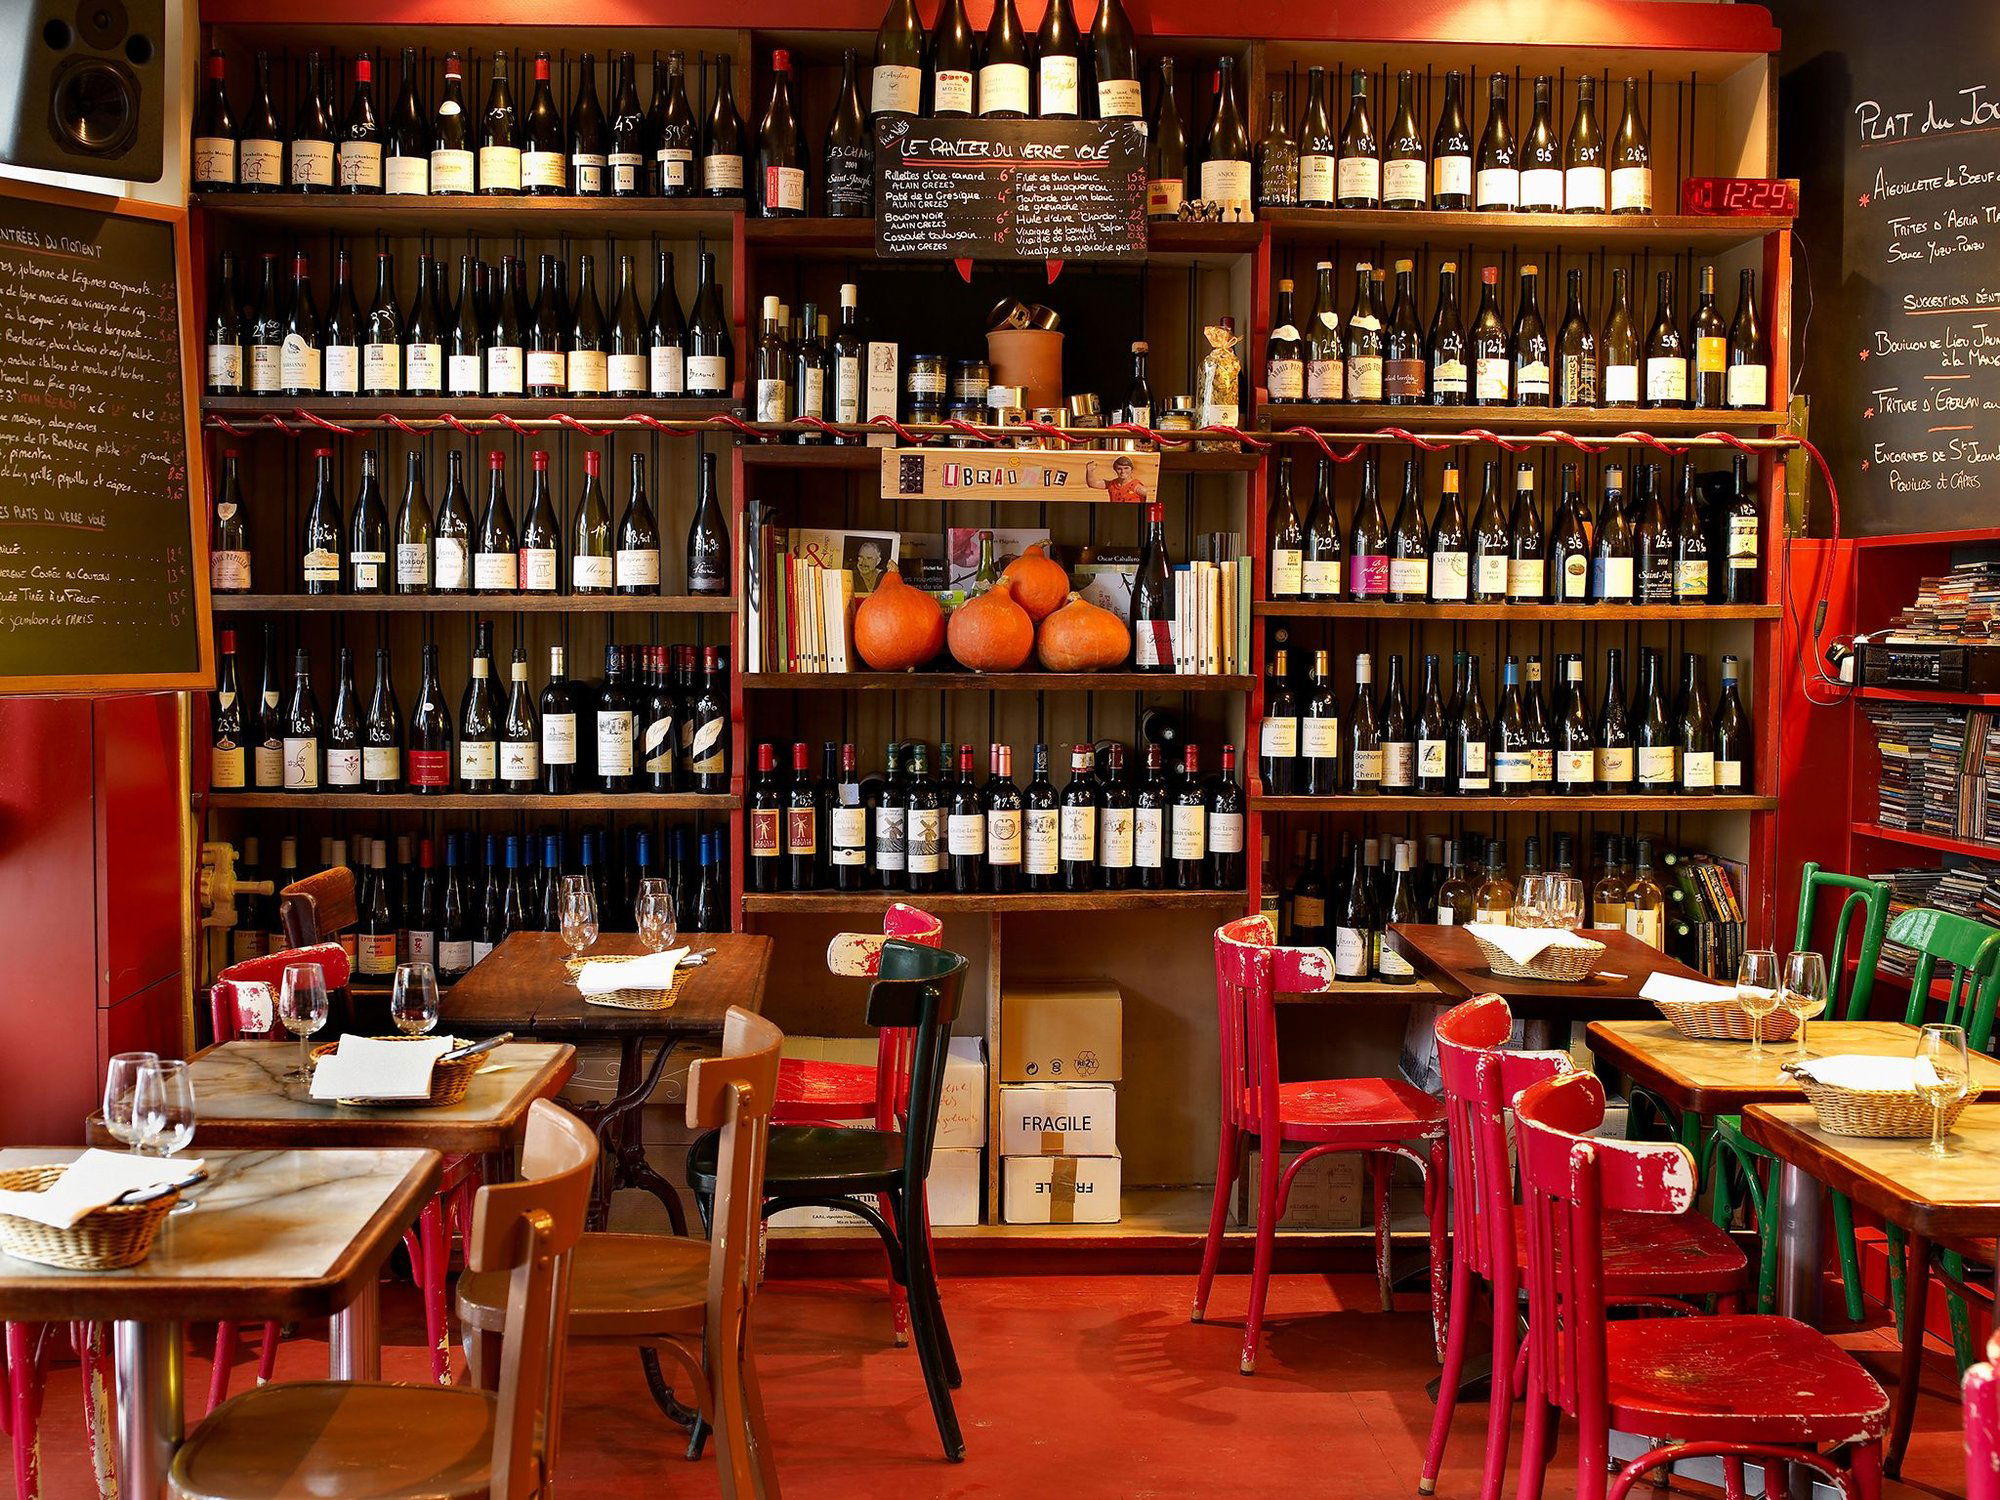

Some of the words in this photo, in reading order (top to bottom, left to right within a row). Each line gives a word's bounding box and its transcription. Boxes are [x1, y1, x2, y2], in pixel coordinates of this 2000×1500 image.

[1921, 99, 1955, 134] du
[900, 138, 929, 157] LE
[928, 137, 991, 157] PANIER
[992, 142, 1014, 157] DU
[1019, 142, 1070, 160] VERRE
[1075, 139, 1116, 160] VOLÉ
[884, 169, 920, 181] Rillettes
[1016, 172, 1038, 182] Filet
[1039, 173, 1051, 182] de
[892, 181, 920, 190] ALAIN
[921, 181, 955, 190] GREZES
[1039, 183, 1051, 192] de
[910, 191, 923, 200] de
[924, 192, 934, 200] la
[1016, 193, 1059, 203] Moutarde
[1074, 194, 1089, 202] vin
[892, 200, 916, 209] ALAIN
[918, 200, 949, 209] GREZES
[1017, 203, 1030, 212] de
[884, 211, 920, 222] BOUDIN
[921, 210, 944, 220] NOIR
[1016, 214, 1042, 225] Huile
[890, 222, 915, 230] ALAIN
[916, 221, 947, 229] GREZES
[0, 226, 40, 248] NTRÉES
[889, 243, 916, 252] ALAIN
[918, 242, 948, 251] GREZES
[1062, 245, 1073, 253] de
[56, 268, 69, 281] de
[1097, 554, 1113, 562] Oscar
[1022, 1116, 1092, 1131] FRAGILE
[1034, 1182, 1094, 1194] FRLE
